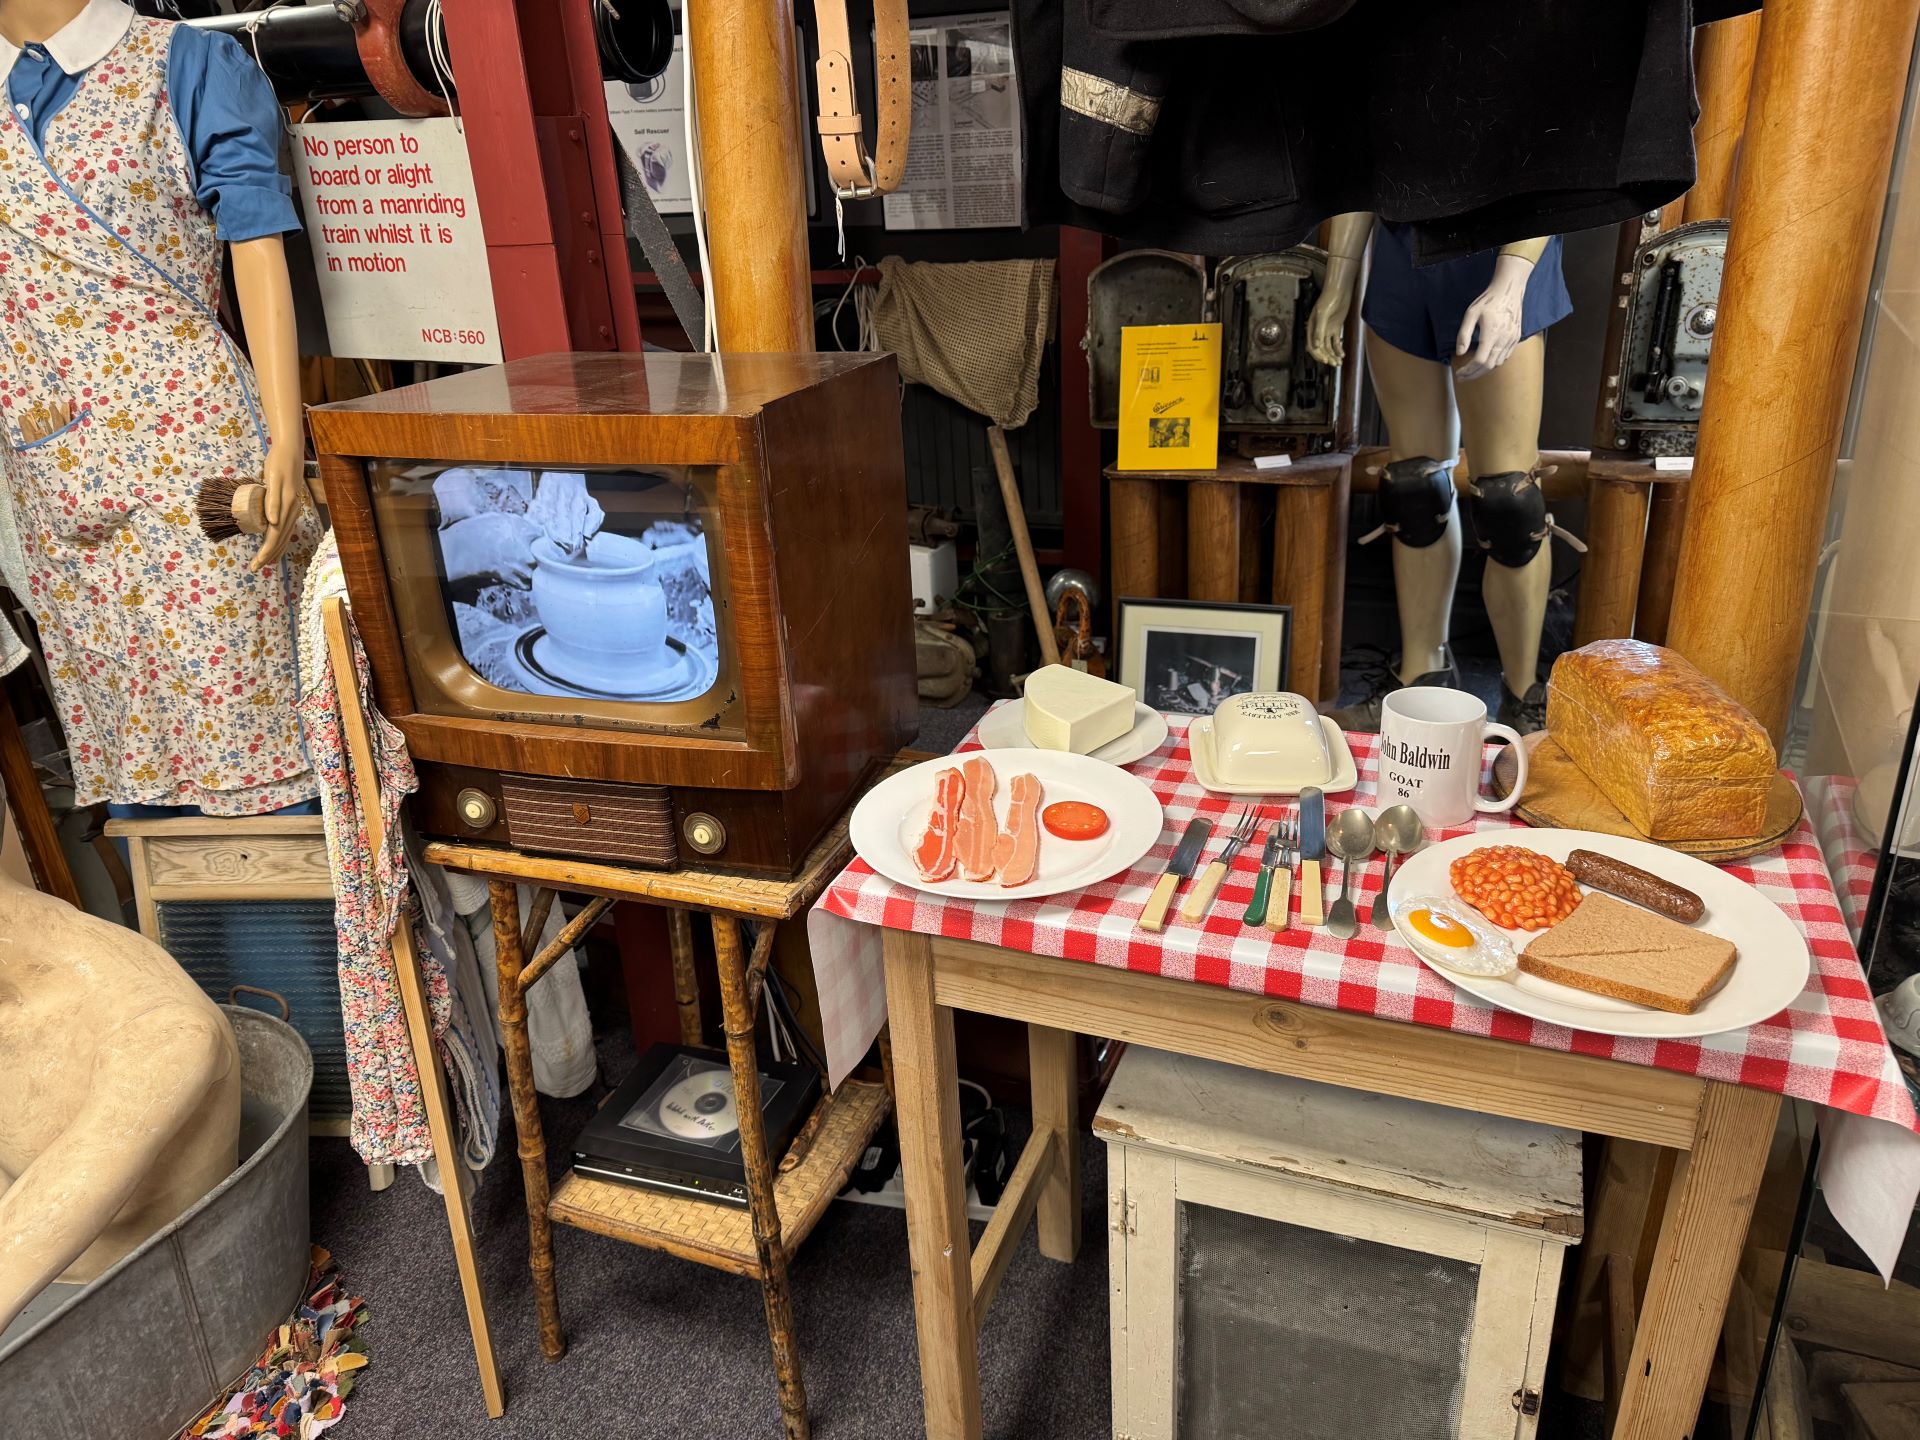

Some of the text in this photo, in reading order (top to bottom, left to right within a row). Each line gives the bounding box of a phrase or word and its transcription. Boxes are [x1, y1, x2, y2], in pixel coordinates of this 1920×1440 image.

[303, 132, 419, 160] No person to
[309, 163, 433, 188] board or alight
[316, 192, 466, 218] from a manriding
[322, 222, 453, 244] train whilst it is
[326, 252, 407, 273] in motion
[421, 328, 485, 345] NCB:560
[1380, 731, 1450, 770] John Baldwin
[1389, 771, 1424, 788] GOAT
[1397, 787, 1410, 798] 86
